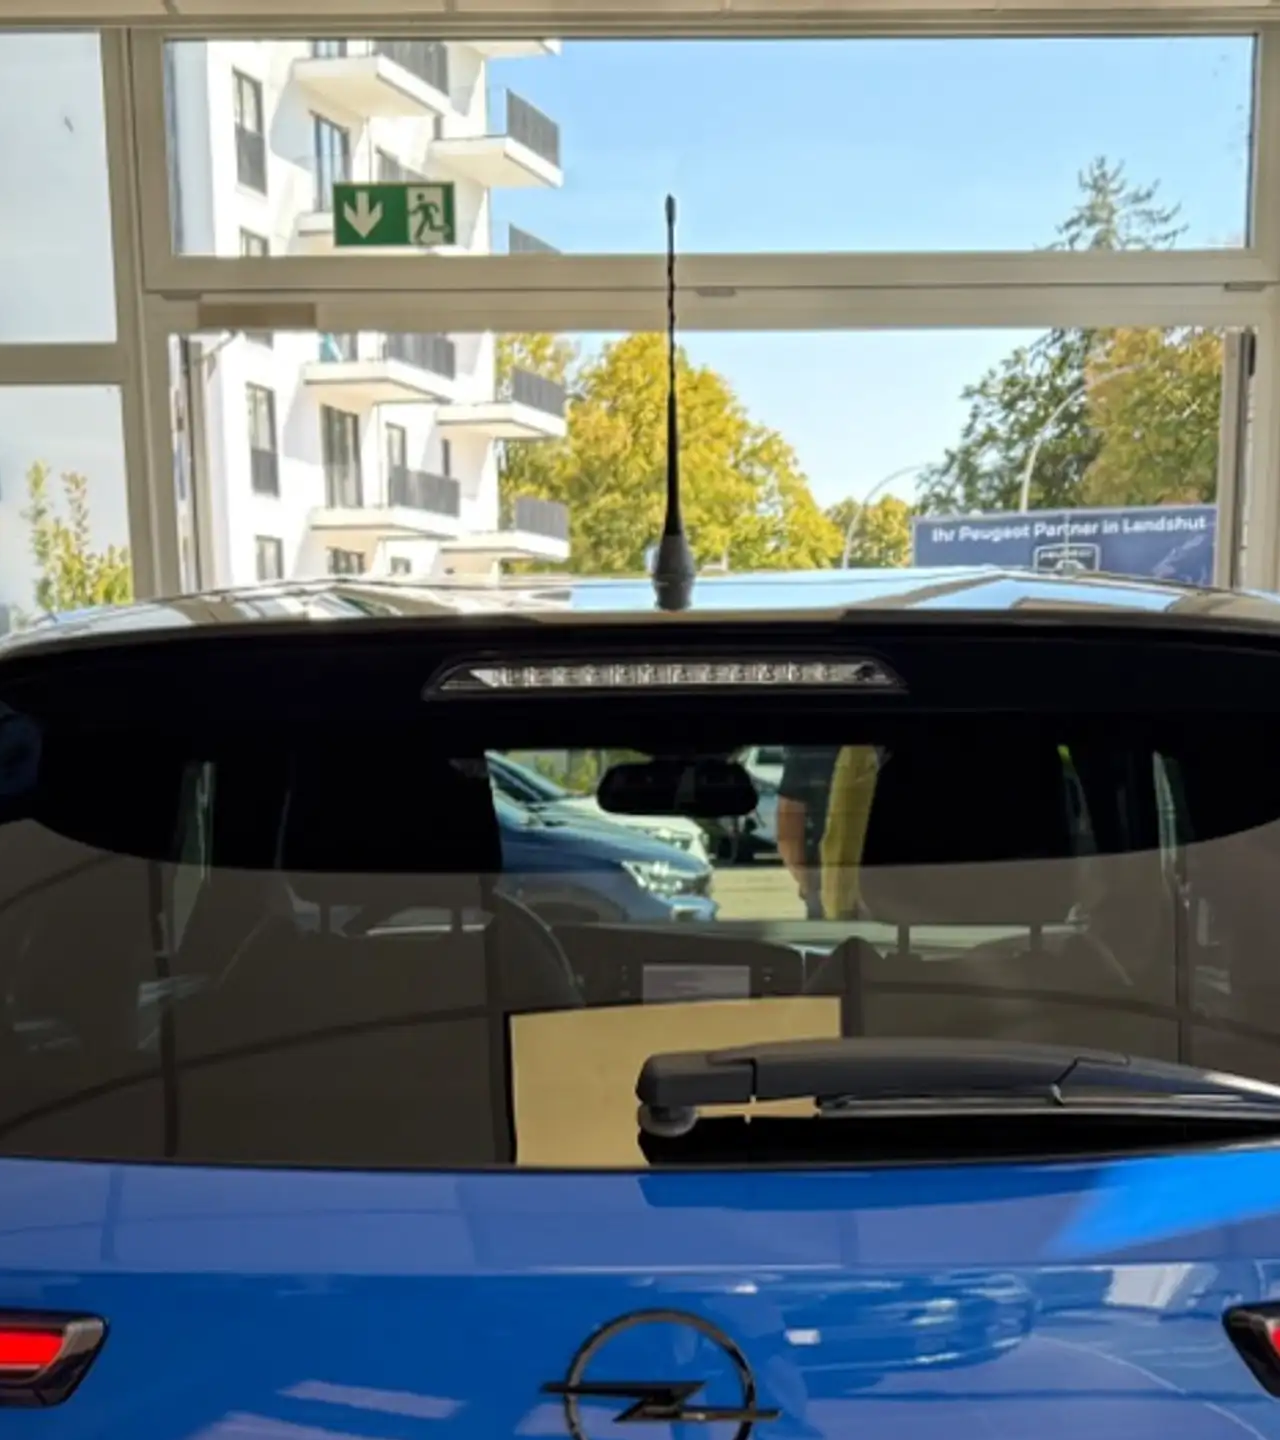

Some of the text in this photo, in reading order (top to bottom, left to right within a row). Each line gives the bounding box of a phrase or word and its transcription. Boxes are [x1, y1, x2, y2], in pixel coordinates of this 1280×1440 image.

[931, 516, 1207, 543] Ihr Peugeot Partner in Landshut
